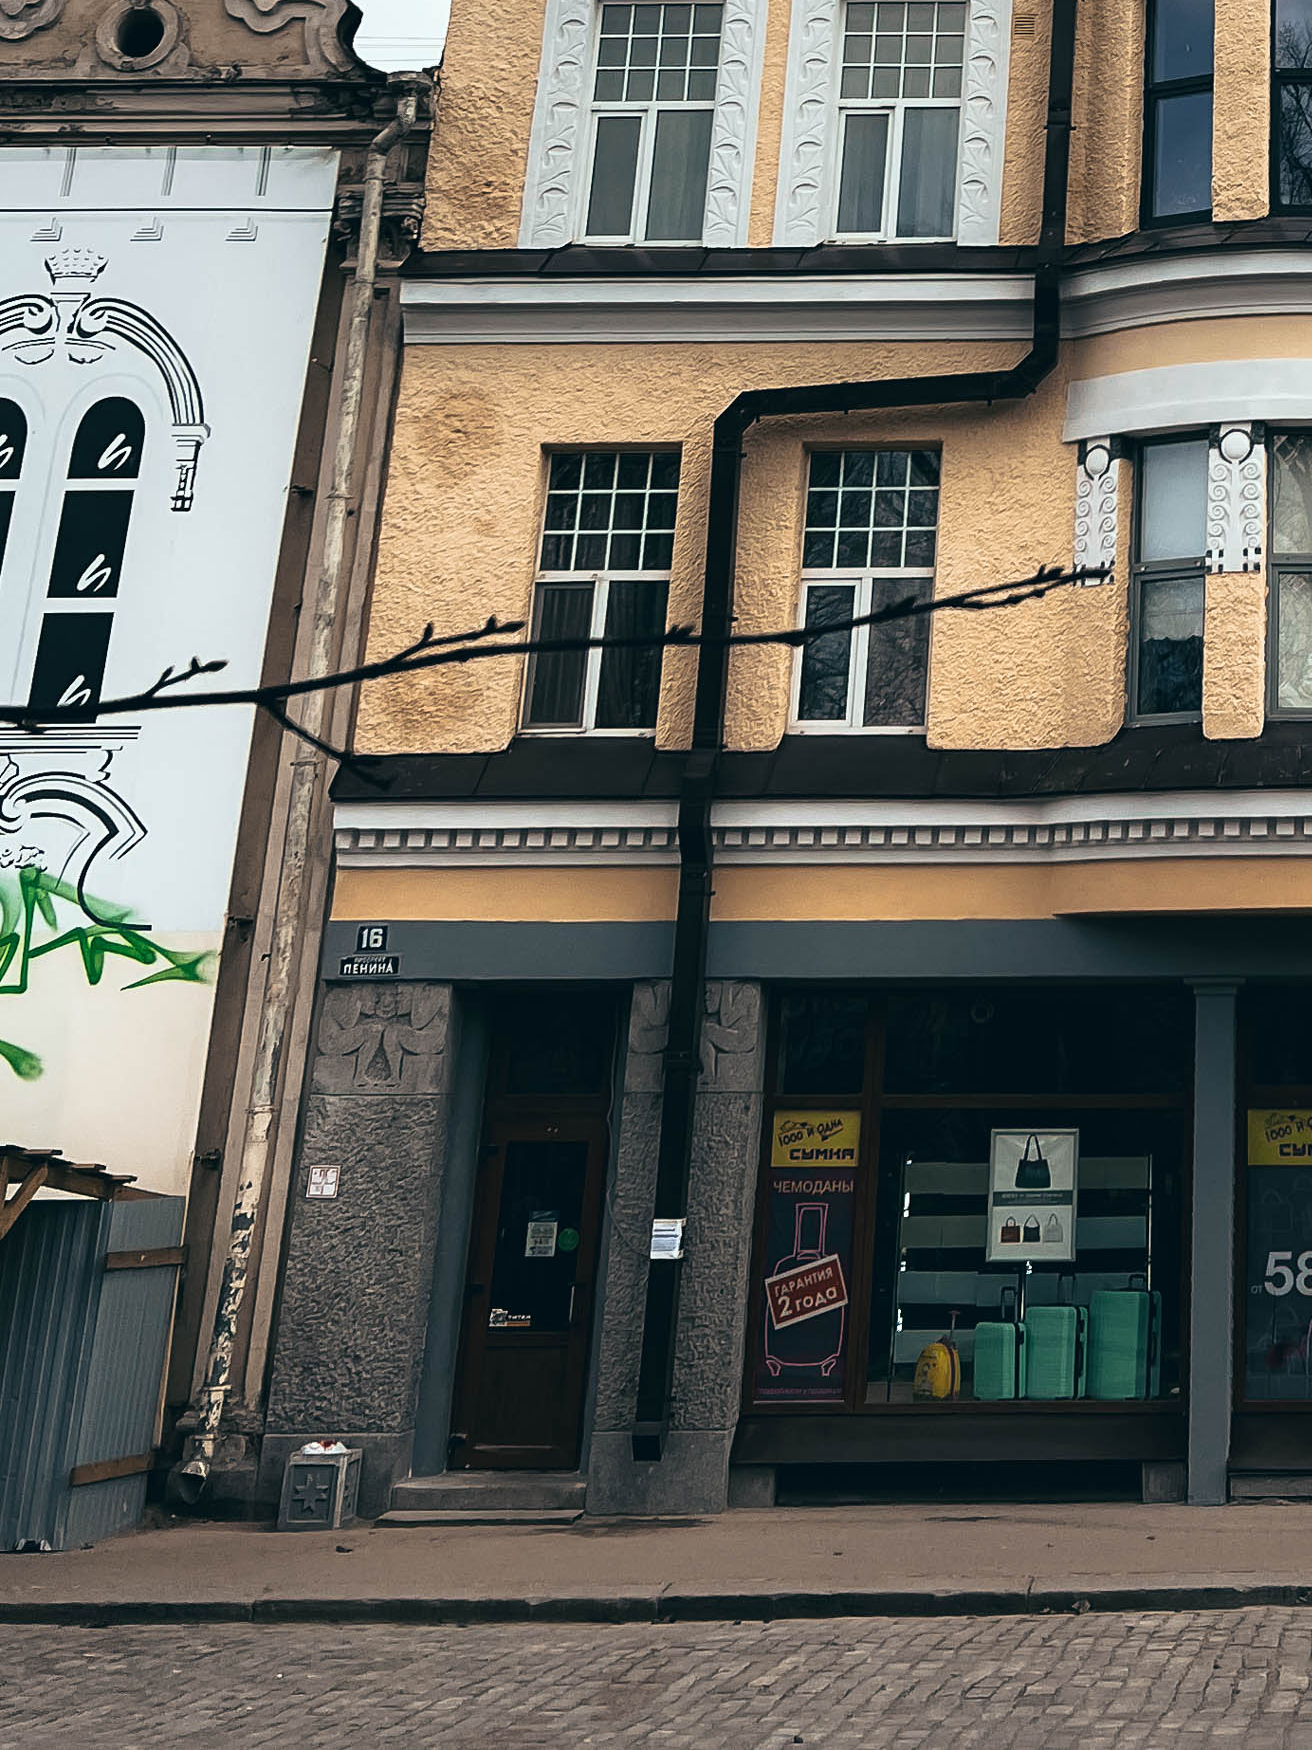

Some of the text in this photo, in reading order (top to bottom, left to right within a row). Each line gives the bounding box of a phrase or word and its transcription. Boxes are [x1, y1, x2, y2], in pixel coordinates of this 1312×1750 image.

[361, 928, 383, 949] 16
[777, 1131, 803, 1146] 1000
[1264, 1125, 1292, 1142] 1000
[789, 1148, 855, 1161] СУМКА
[773, 1179, 854, 1195] ЧЕМОДАНЫ
[774, 1266, 833, 1298] ГАРАНТИЯ
[778, 1296, 793, 1318] 2
